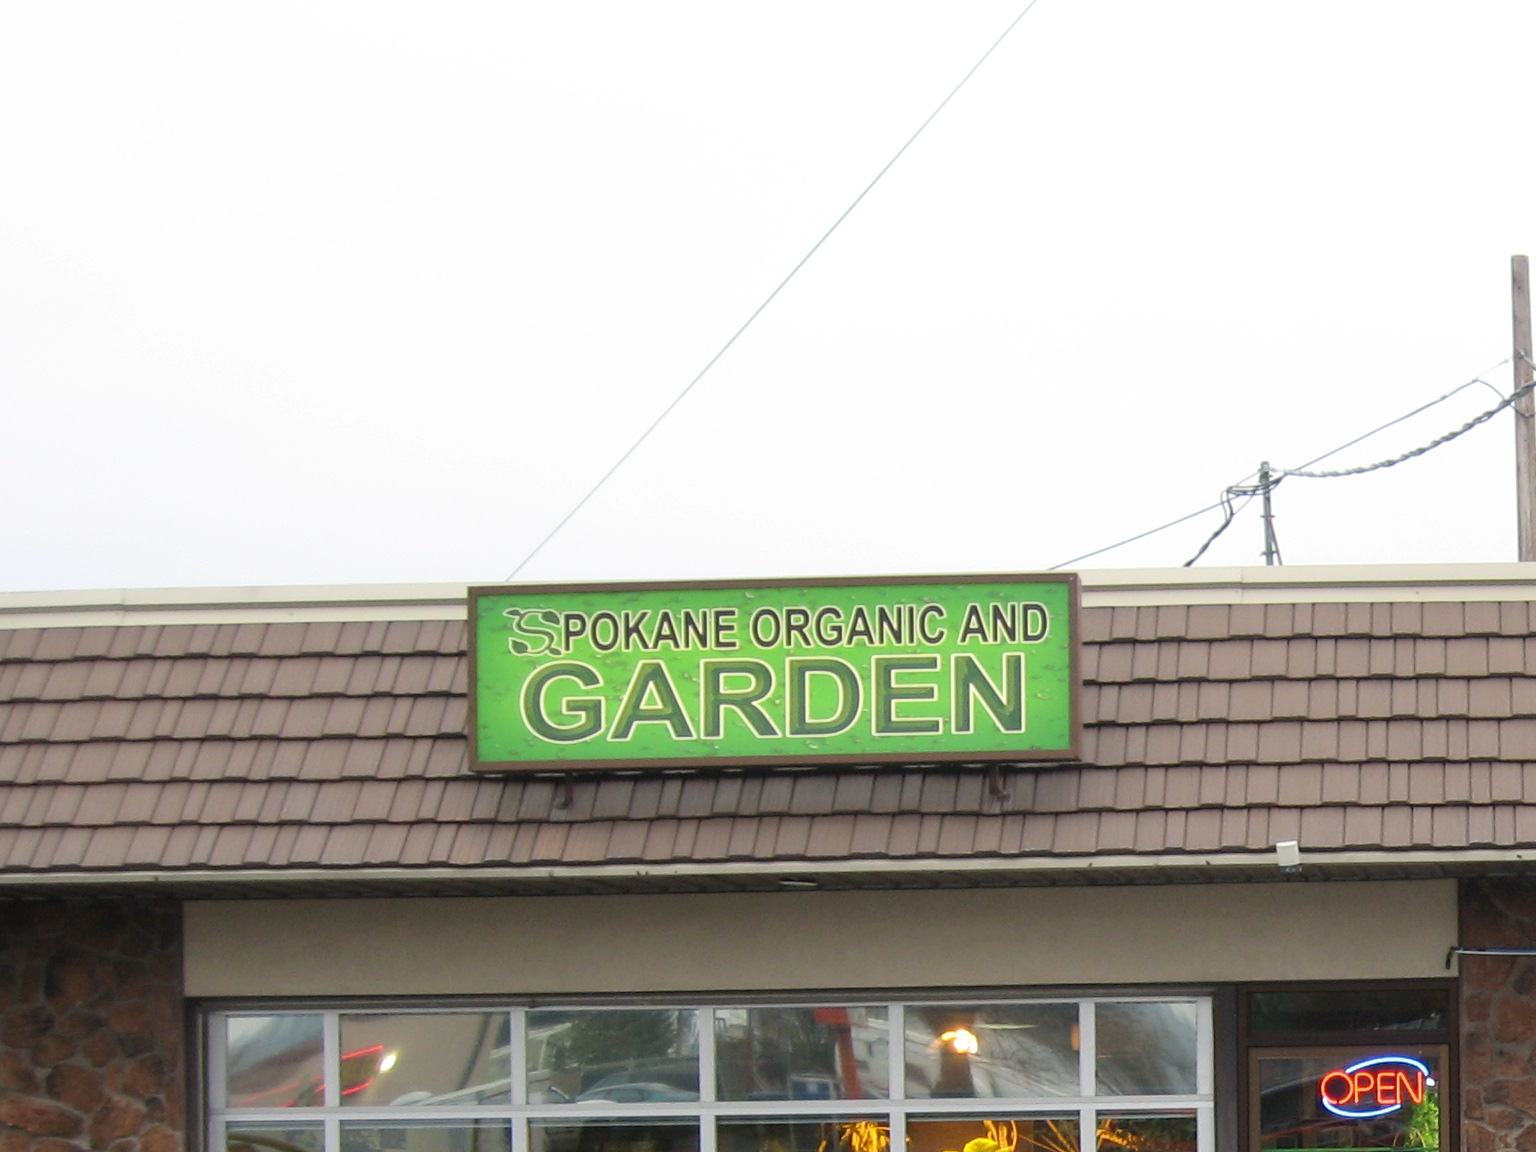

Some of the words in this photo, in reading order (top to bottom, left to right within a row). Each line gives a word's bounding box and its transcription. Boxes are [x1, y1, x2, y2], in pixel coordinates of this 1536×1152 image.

[503, 605, 738, 656] SPOKANE
[750, 602, 947, 649] ORGANIC
[957, 600, 1049, 645] AND
[519, 651, 1028, 744] GARDEN
[1318, 1069, 1425, 1106] OPEN
